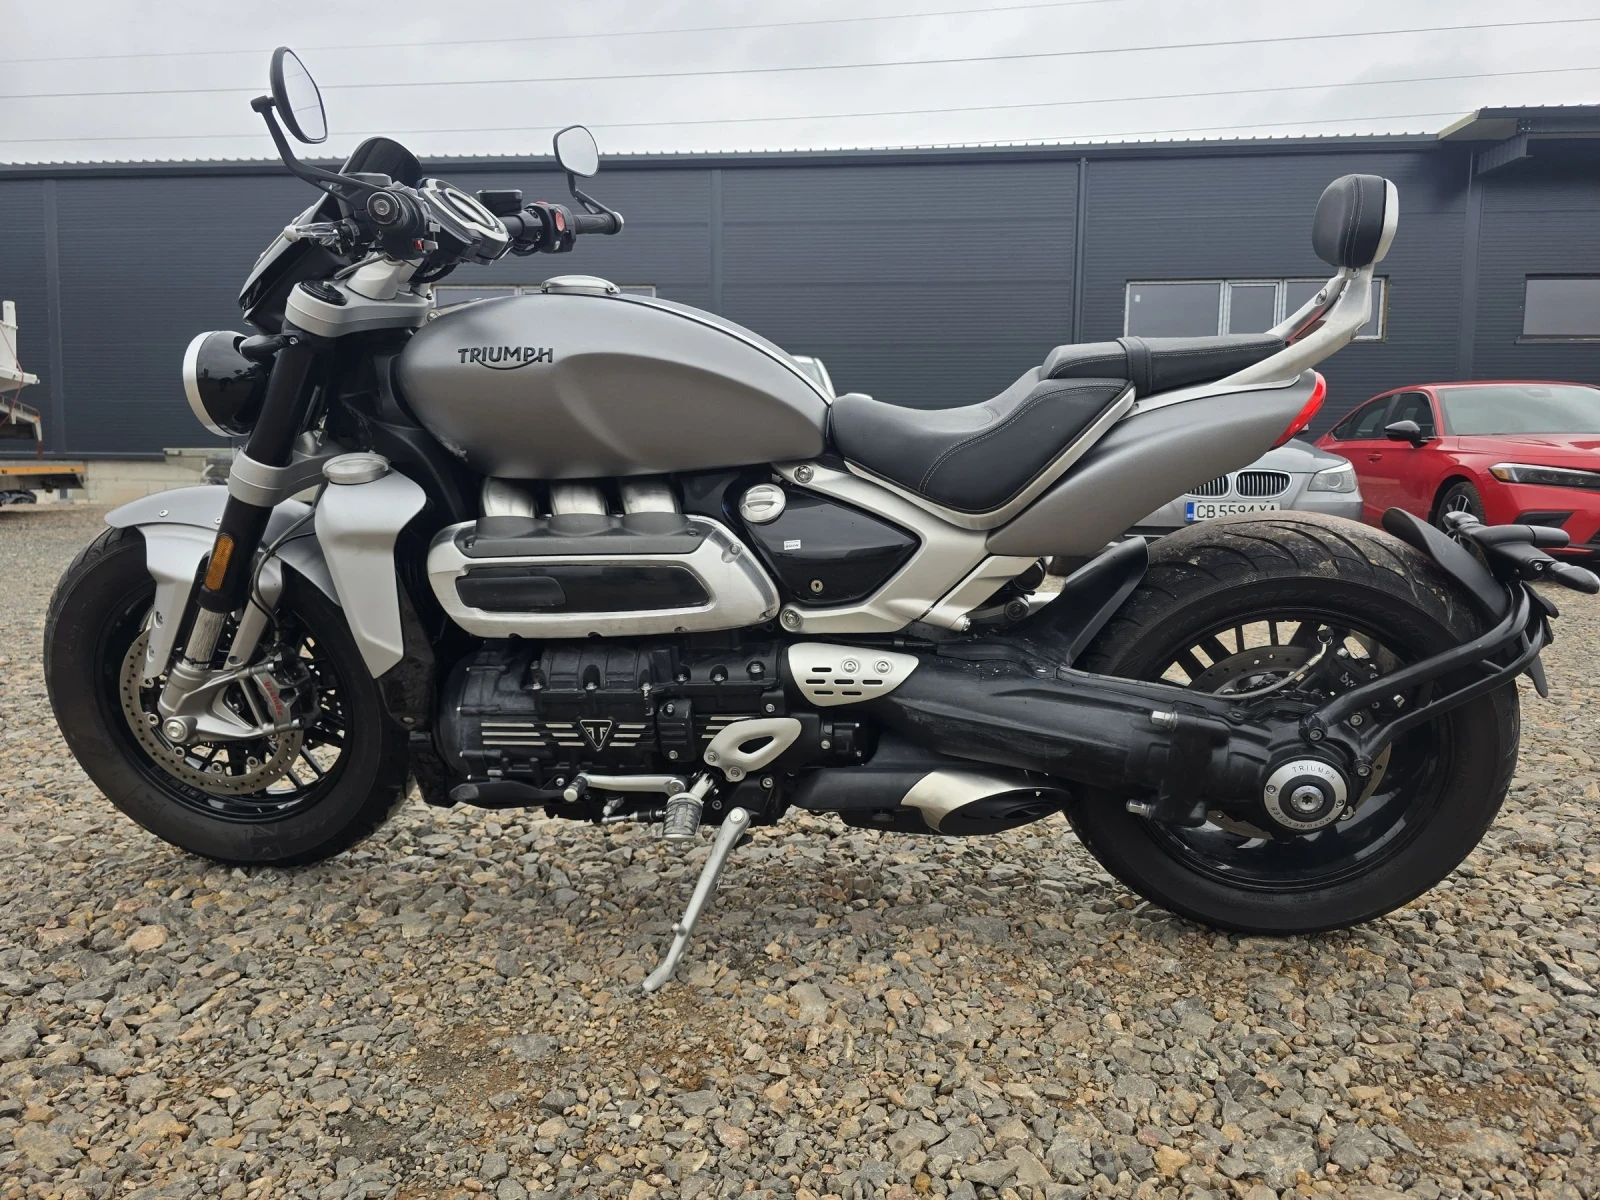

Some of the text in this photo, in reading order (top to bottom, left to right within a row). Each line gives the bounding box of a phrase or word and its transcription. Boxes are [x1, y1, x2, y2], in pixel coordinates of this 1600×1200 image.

[457, 346, 554, 371] TRIUMPH
[1196, 504, 1216, 519] CB
[1292, 765, 1336, 780] TRIUMPH
[1271, 806, 1331, 828] MOTORCYCLES
